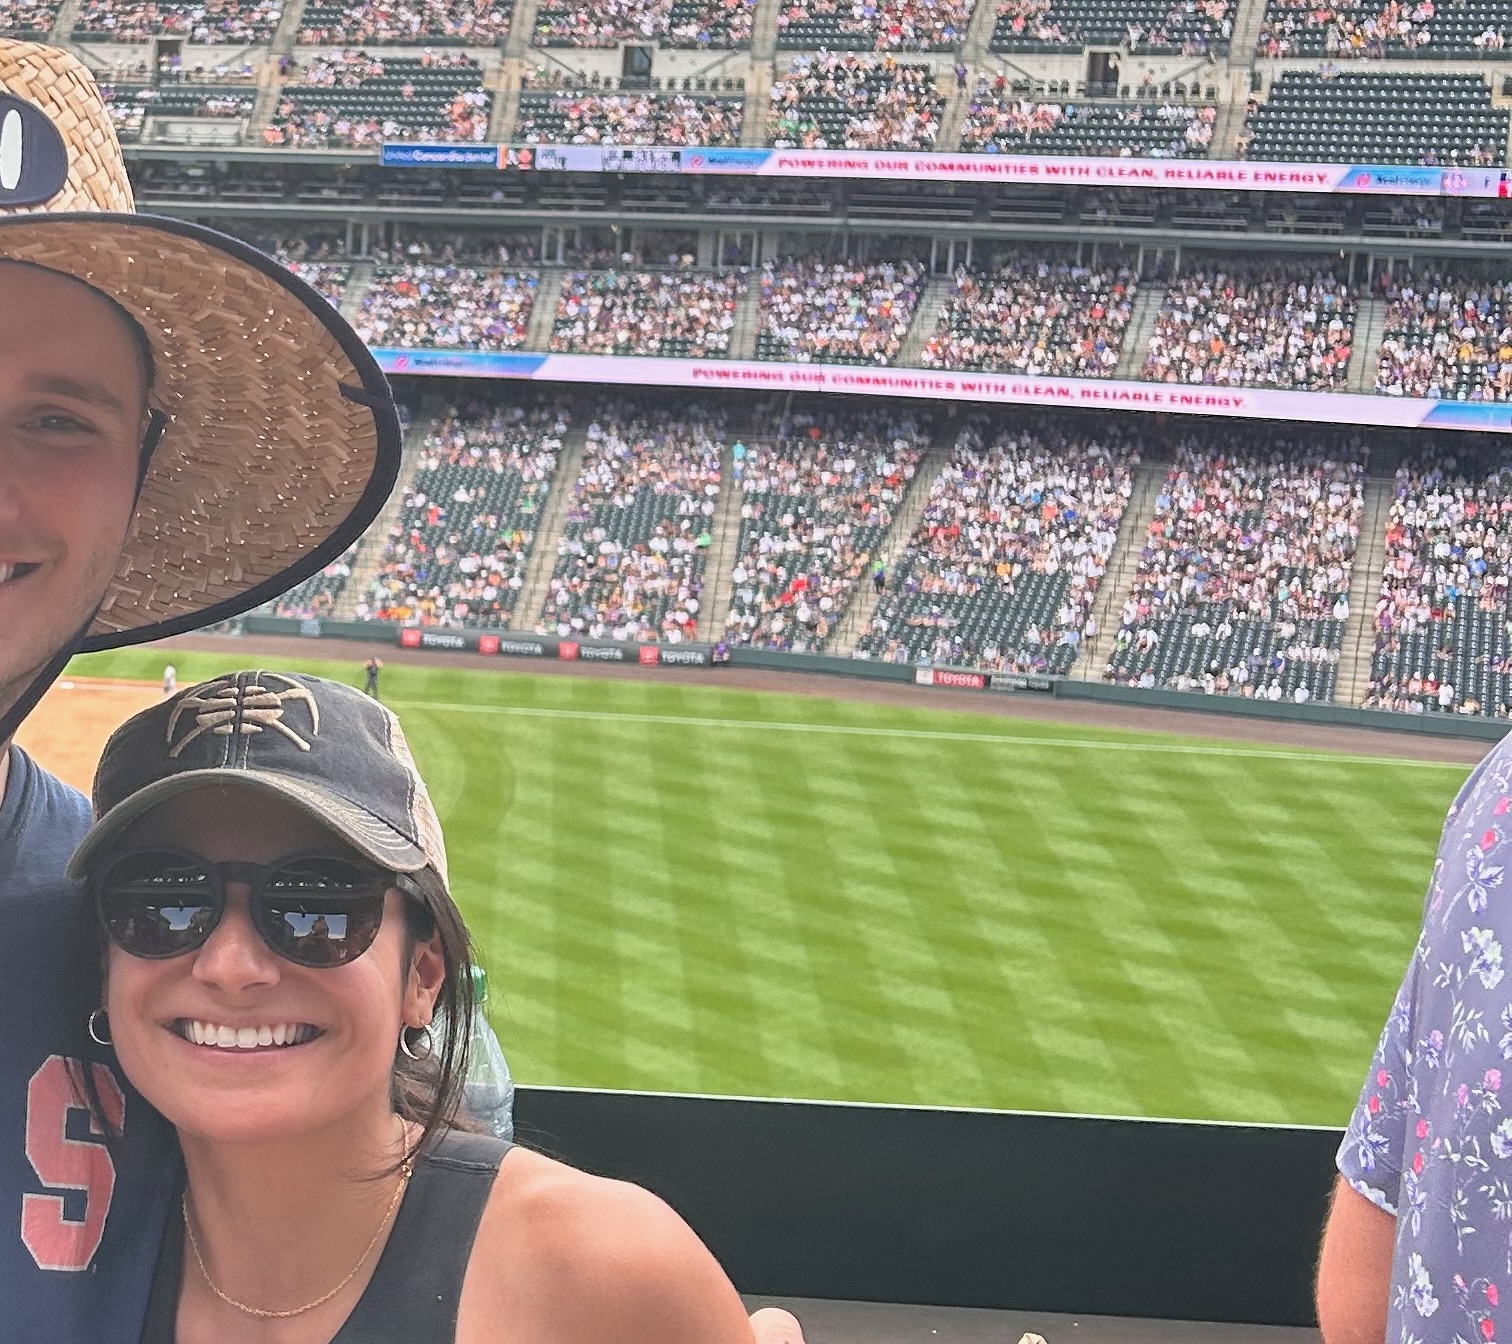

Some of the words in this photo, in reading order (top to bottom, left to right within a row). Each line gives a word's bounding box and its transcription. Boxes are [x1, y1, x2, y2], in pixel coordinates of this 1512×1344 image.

[779, 157, 868, 171] POWERING
[875, 159, 908, 172] OUR
[915, 160, 1039, 175] COMMUNITIES
[1045, 166, 1089, 177] WITH
[1165, 169, 1247, 181] RELIABLE
[692, 367, 784, 382] POWERING
[790, 369, 826, 383] OUR
[832, 372, 956, 391] COMMUNITIES
[961, 381, 1006, 394] WITH
[1081, 389, 1163, 404] RELIABLE
[937, 671, 980, 687] TOYOTA
[20, 1054, 126, 1272] S
